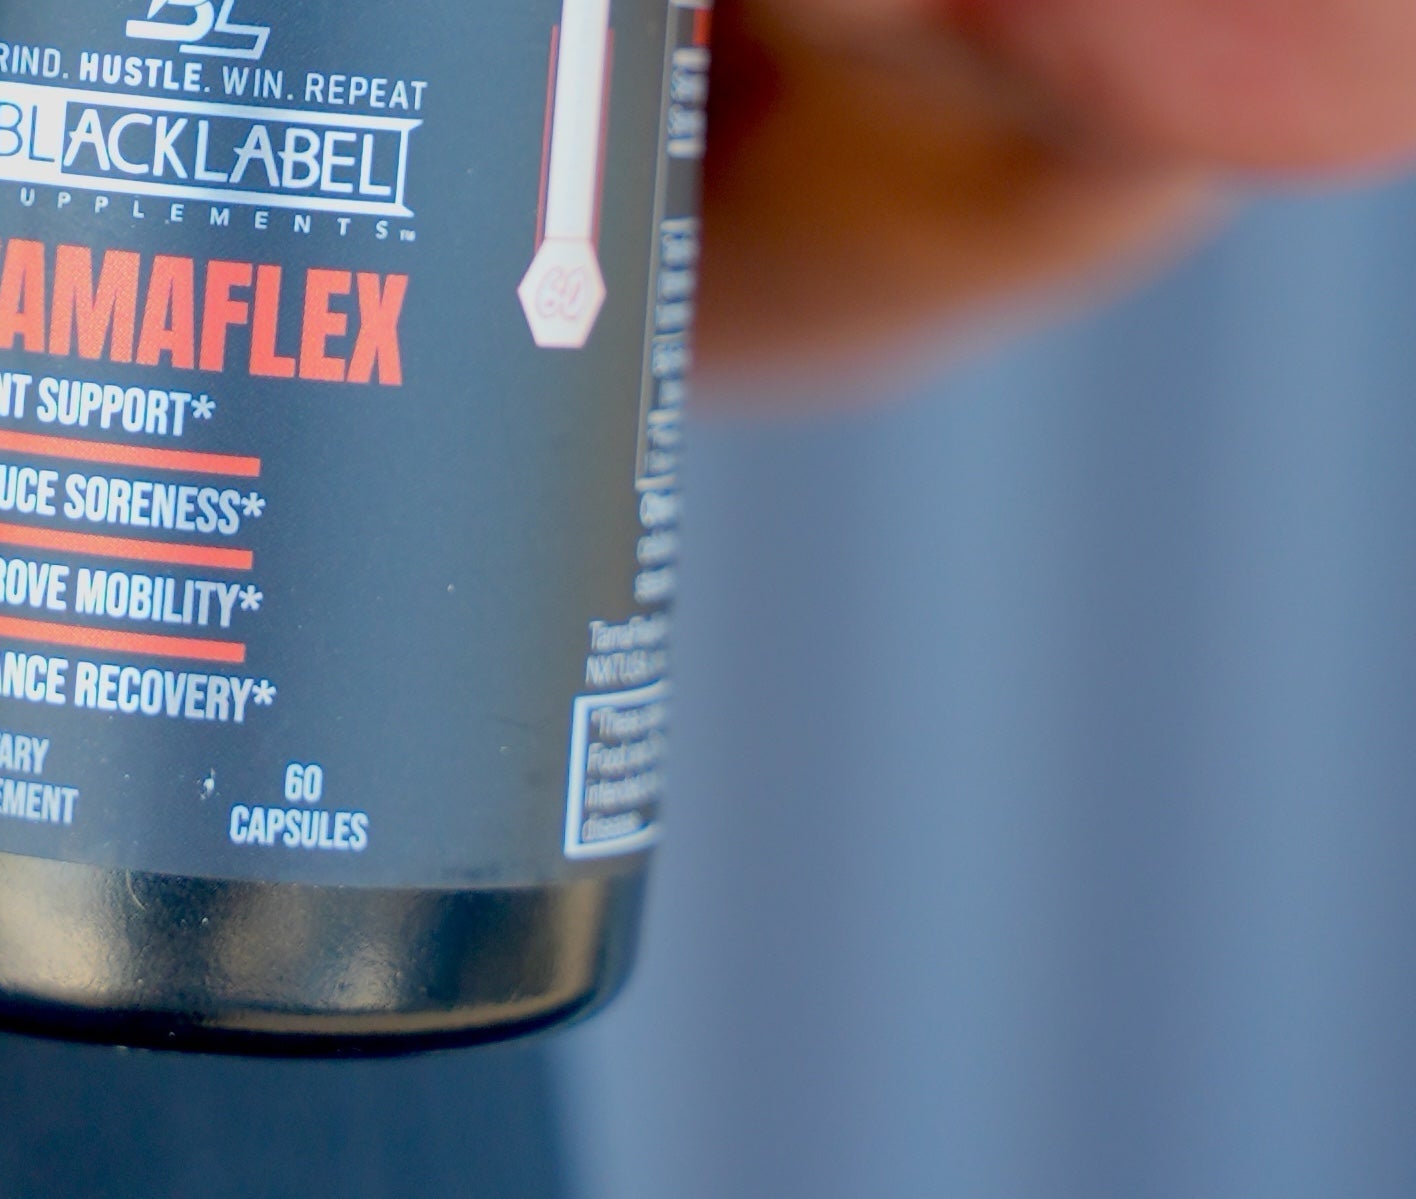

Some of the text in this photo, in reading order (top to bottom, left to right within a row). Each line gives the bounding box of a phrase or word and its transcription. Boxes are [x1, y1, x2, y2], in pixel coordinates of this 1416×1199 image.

[78, 52, 211, 94] HUSTLE.
[221, 65, 294, 101] WIN.
[303, 72, 428, 111] REPEAT
[284, 762, 323, 804] 60
[229, 804, 369, 852] CAPSULES
